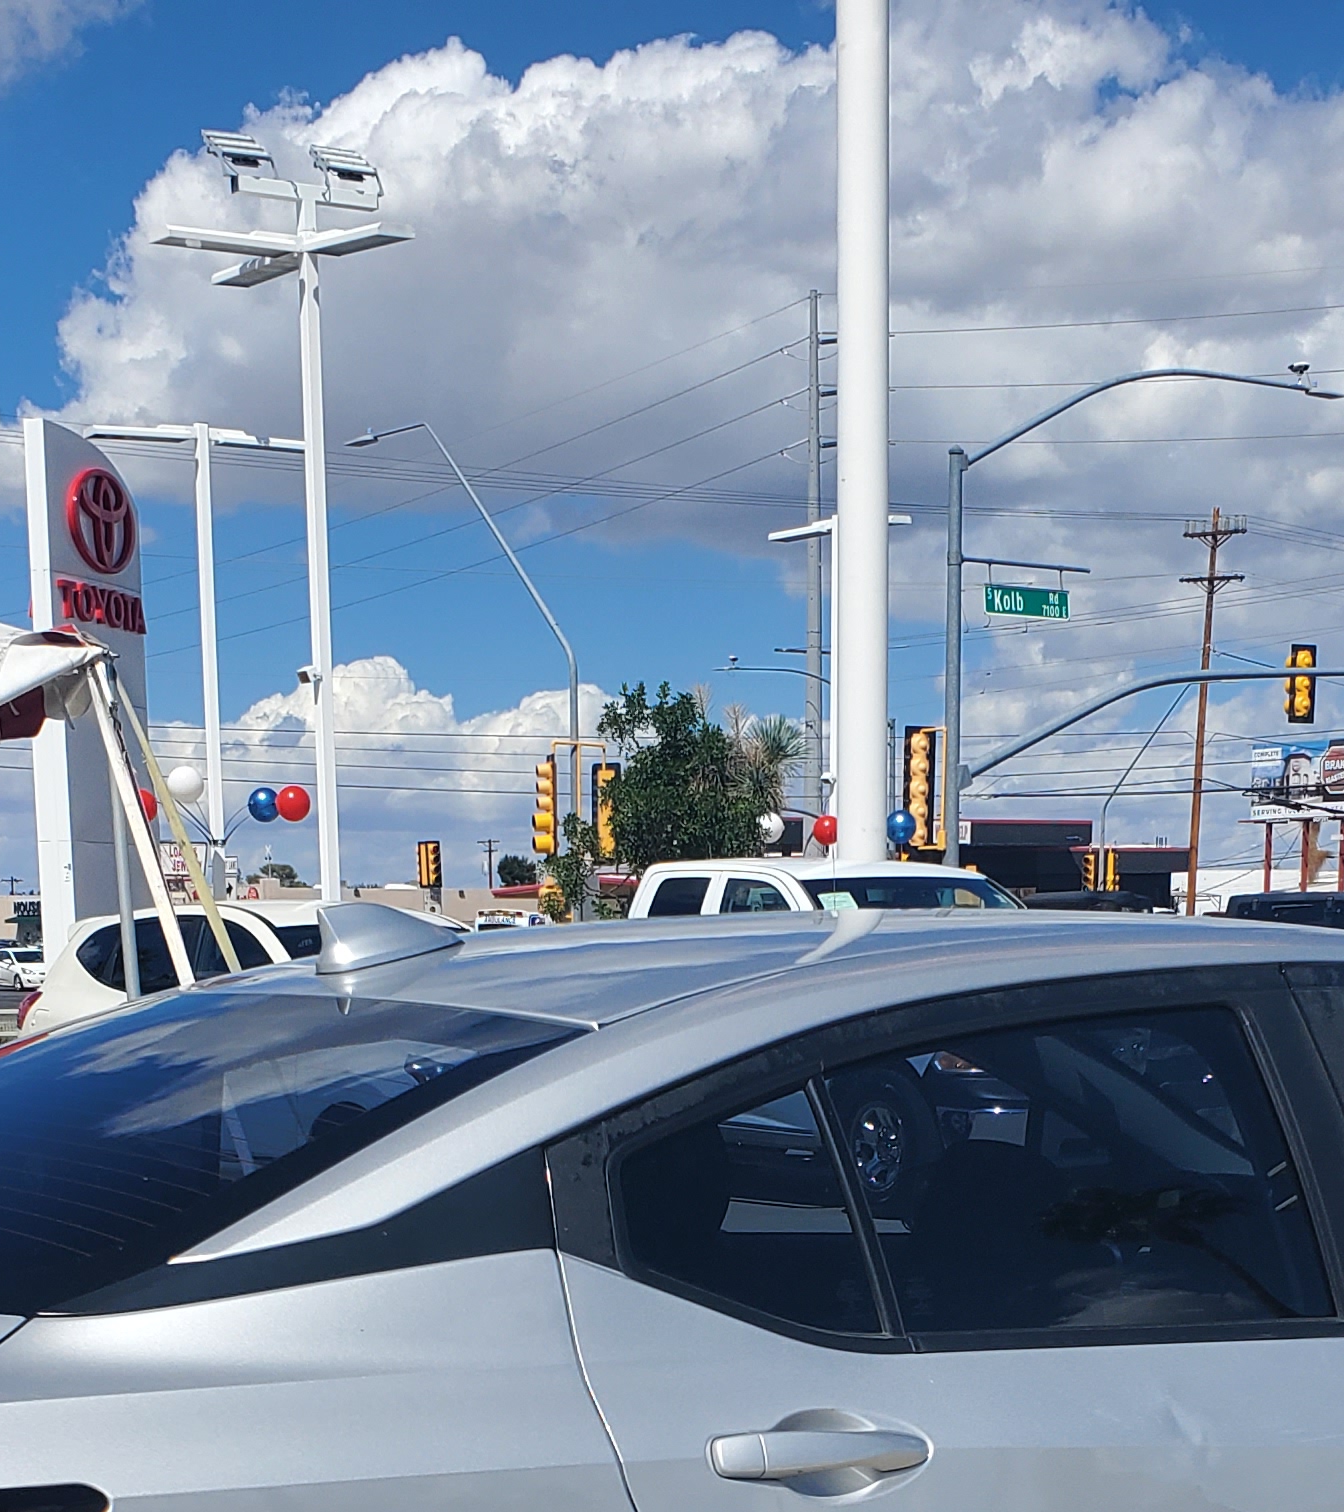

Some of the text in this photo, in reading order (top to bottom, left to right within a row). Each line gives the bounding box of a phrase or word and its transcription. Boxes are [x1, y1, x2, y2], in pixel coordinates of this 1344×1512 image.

[56, 579, 147, 634] TOYOTA
[987, 588, 1059, 611] S Kolb Rd
[1042, 605, 1067, 617] 7100 E
[1253, 808, 1281, 816] SERVING
